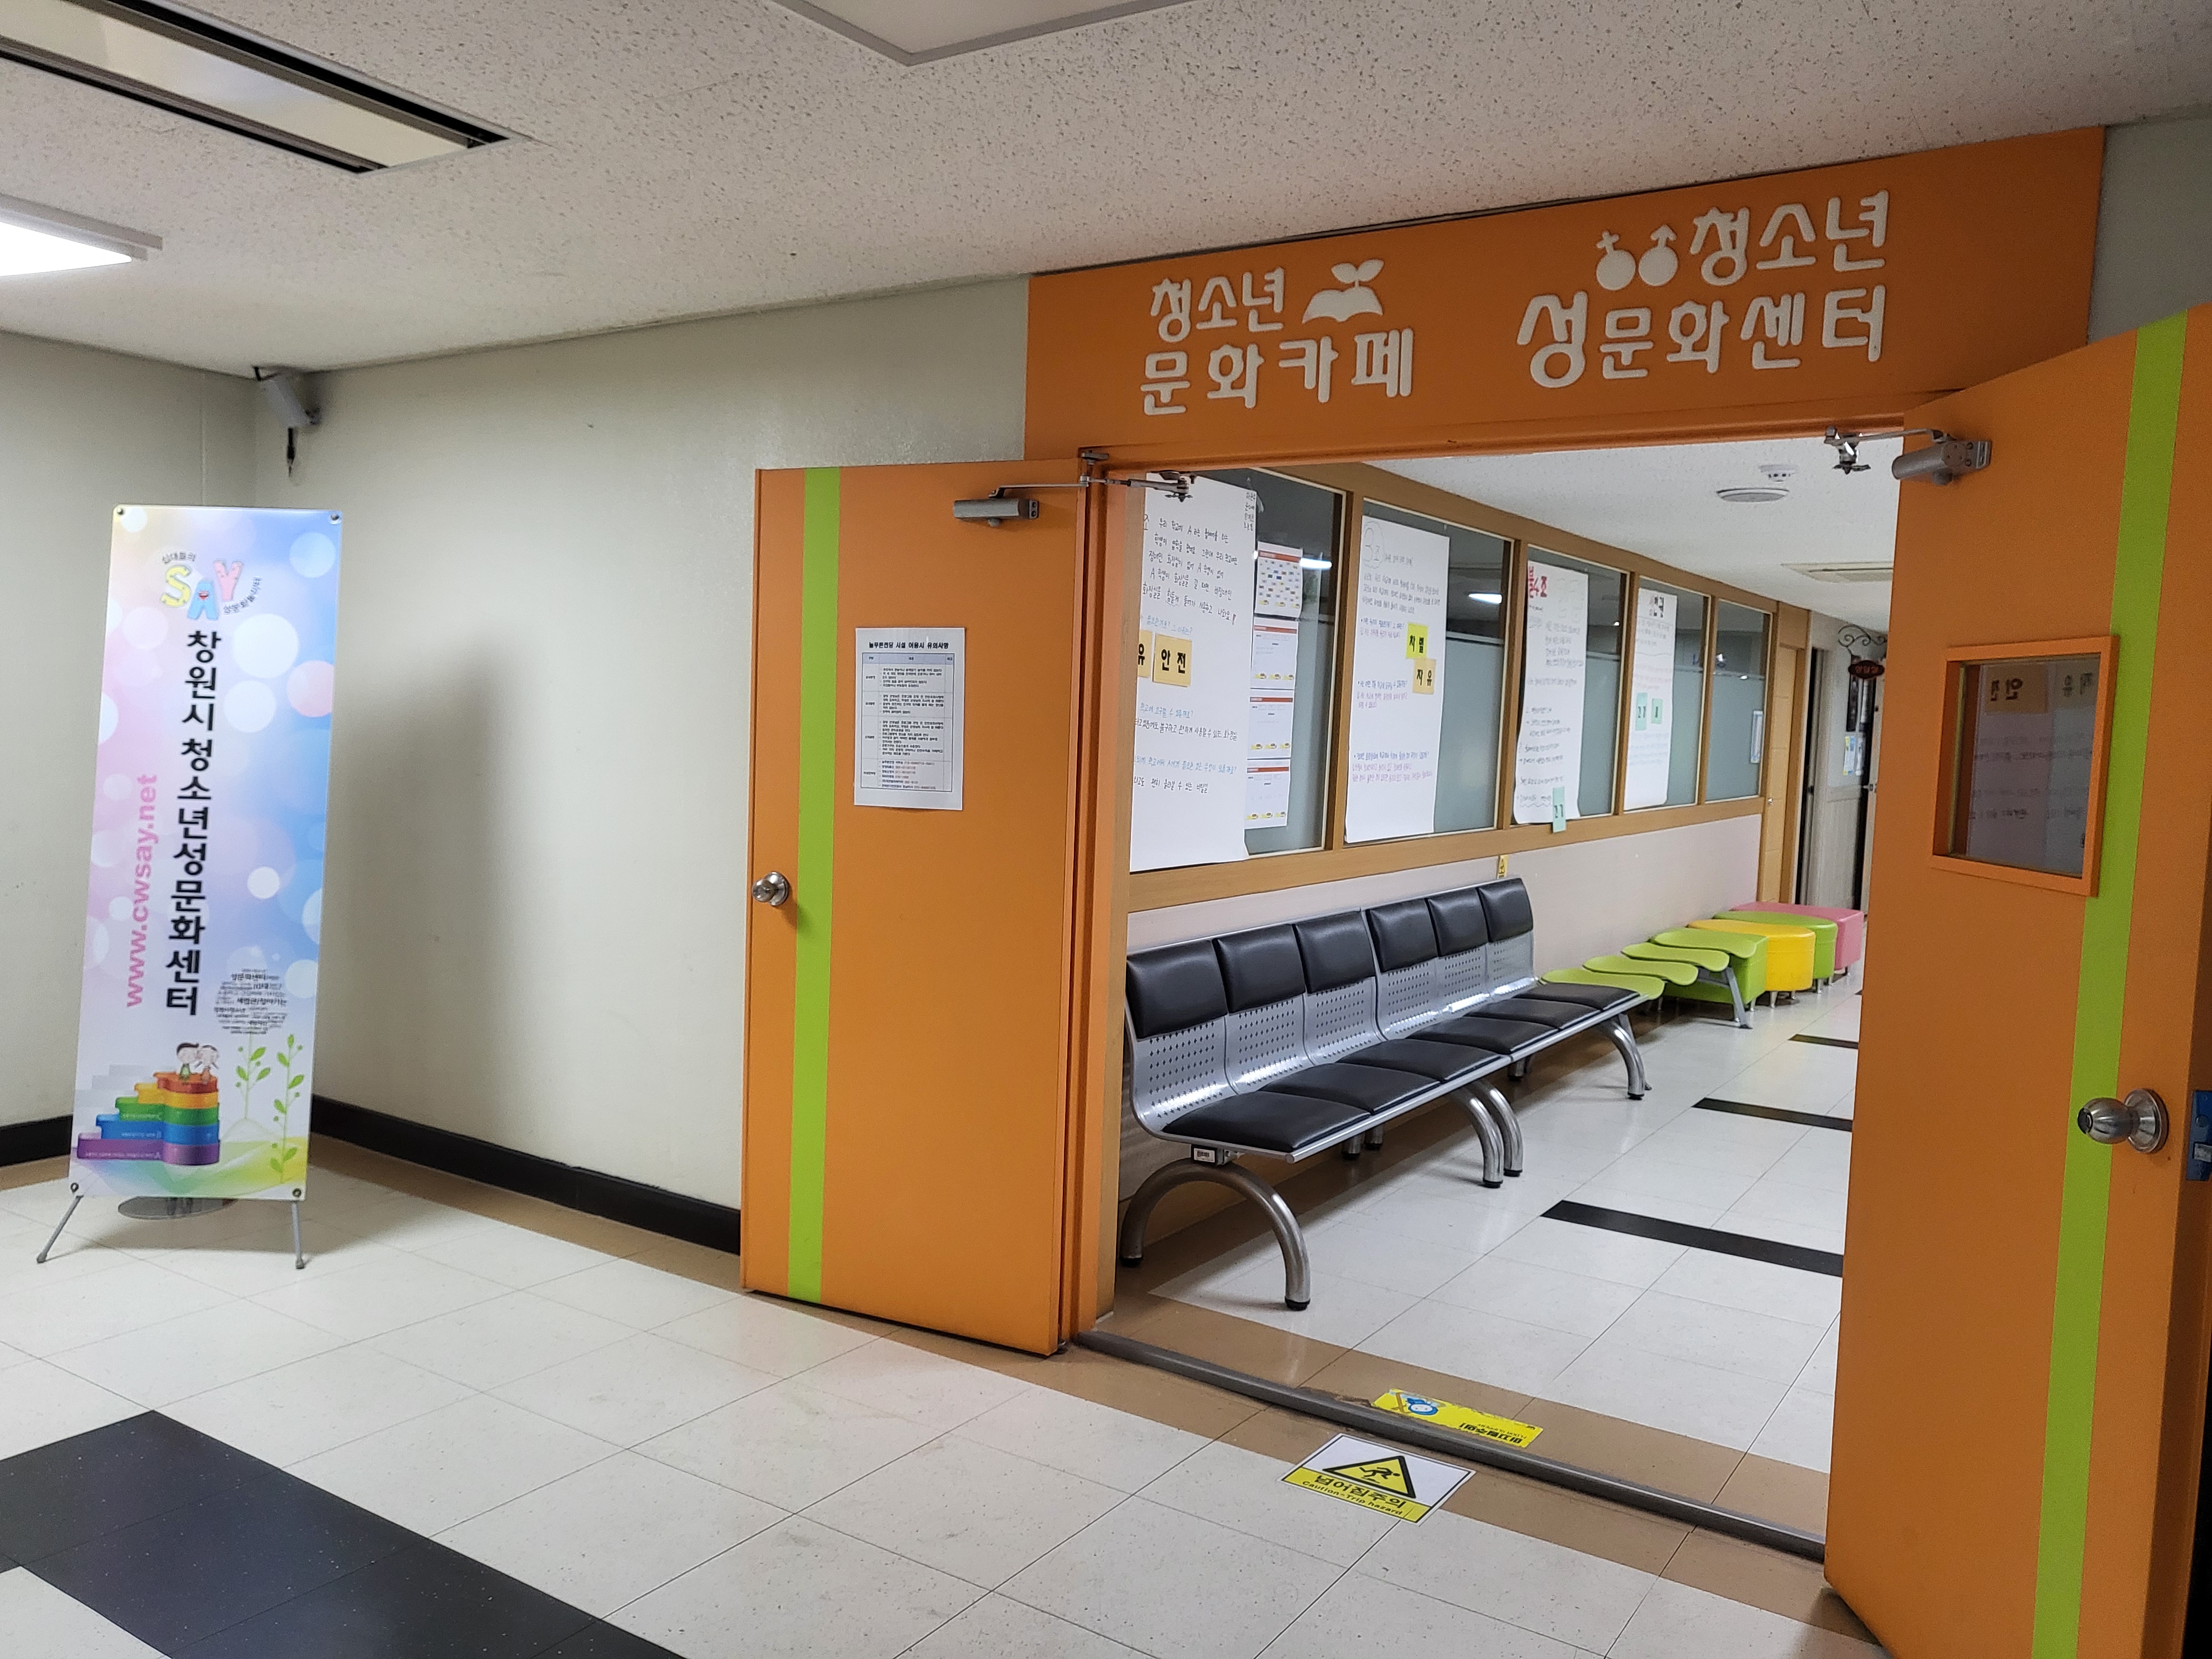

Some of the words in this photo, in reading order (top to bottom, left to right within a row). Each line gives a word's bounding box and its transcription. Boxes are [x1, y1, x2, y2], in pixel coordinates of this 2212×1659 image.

[1690, 189, 1889, 286] 청소년
[1150, 267, 1285, 343] 청소년
[1516, 284, 1886, 388] 성문화센터
[1140, 327, 1414, 416] 문화카페
[160, 558, 244, 620] SAY
[1161, 649, 1186, 674] 안전
[1409, 635, 1425, 653] 차별
[1416, 669, 1432, 686] 자유
[126, 775, 159, 1006] www.cwsay.net
[1314, 1475, 1406, 1509] 넘어짐주의
[1368, 1501, 1403, 1516] hazard
